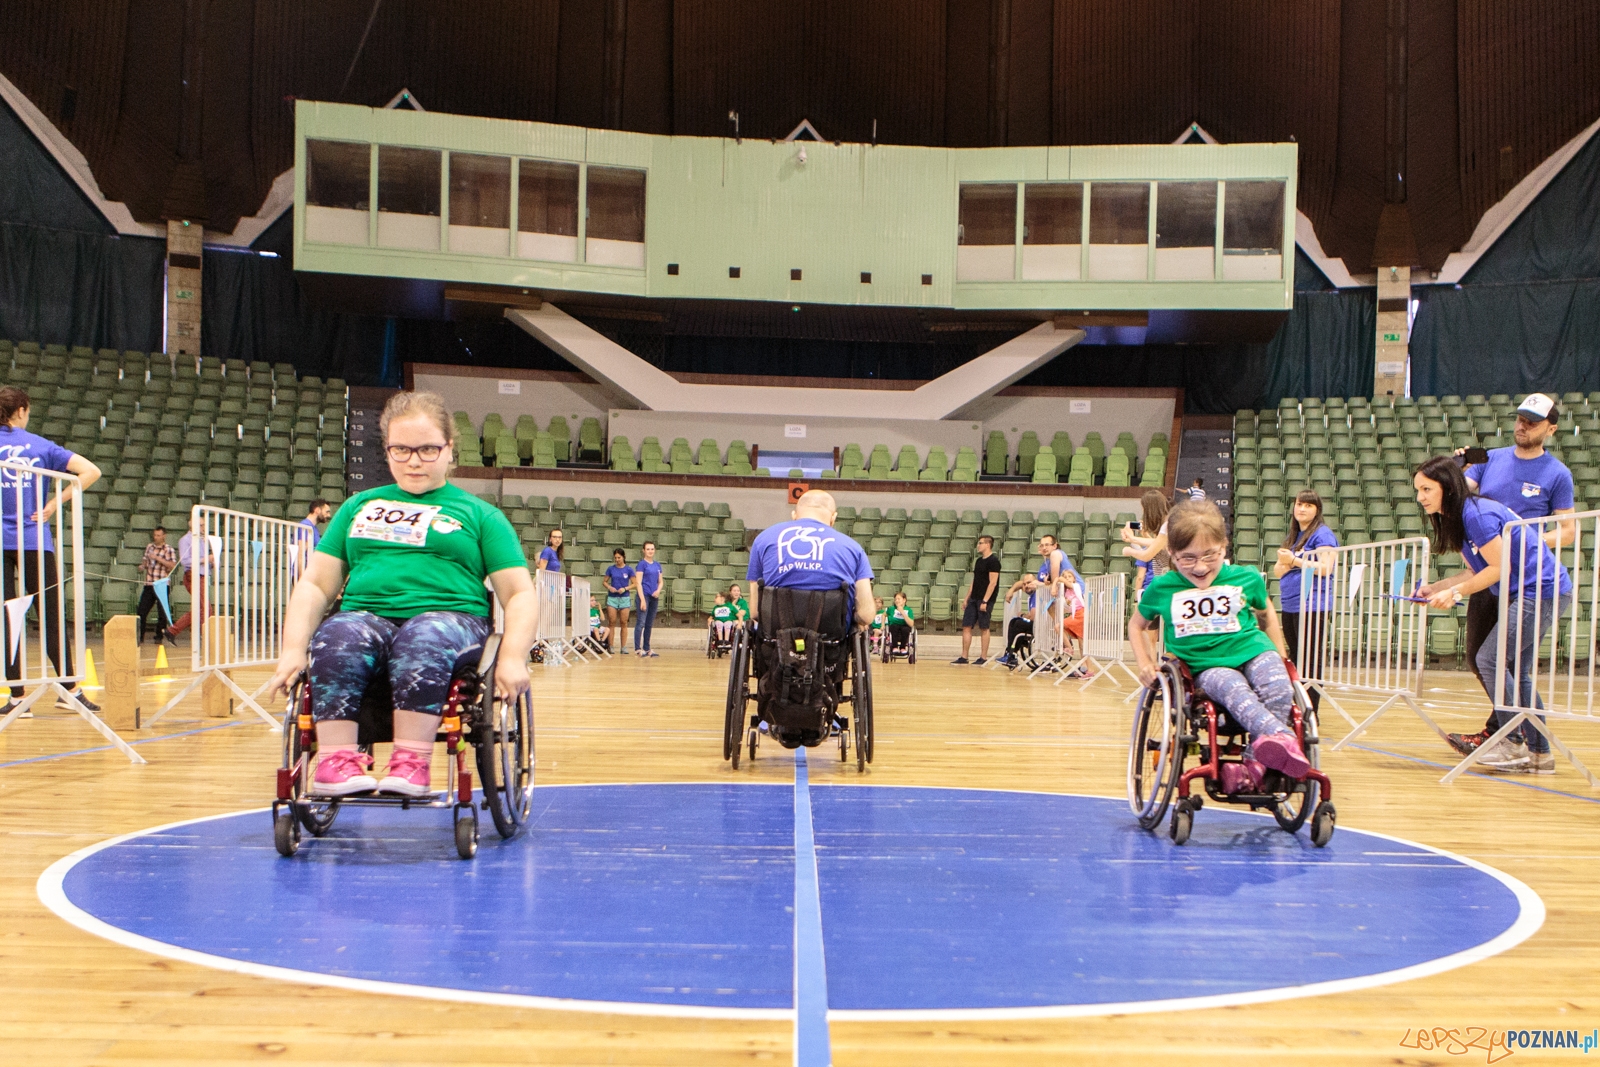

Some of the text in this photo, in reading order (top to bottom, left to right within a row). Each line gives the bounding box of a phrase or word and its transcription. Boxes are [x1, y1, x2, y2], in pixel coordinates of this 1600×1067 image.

[792, 487, 803, 499] C
[366, 507, 424, 526] 304
[794, 561, 823, 570] WLKP.
[1182, 595, 1231, 619] 303
